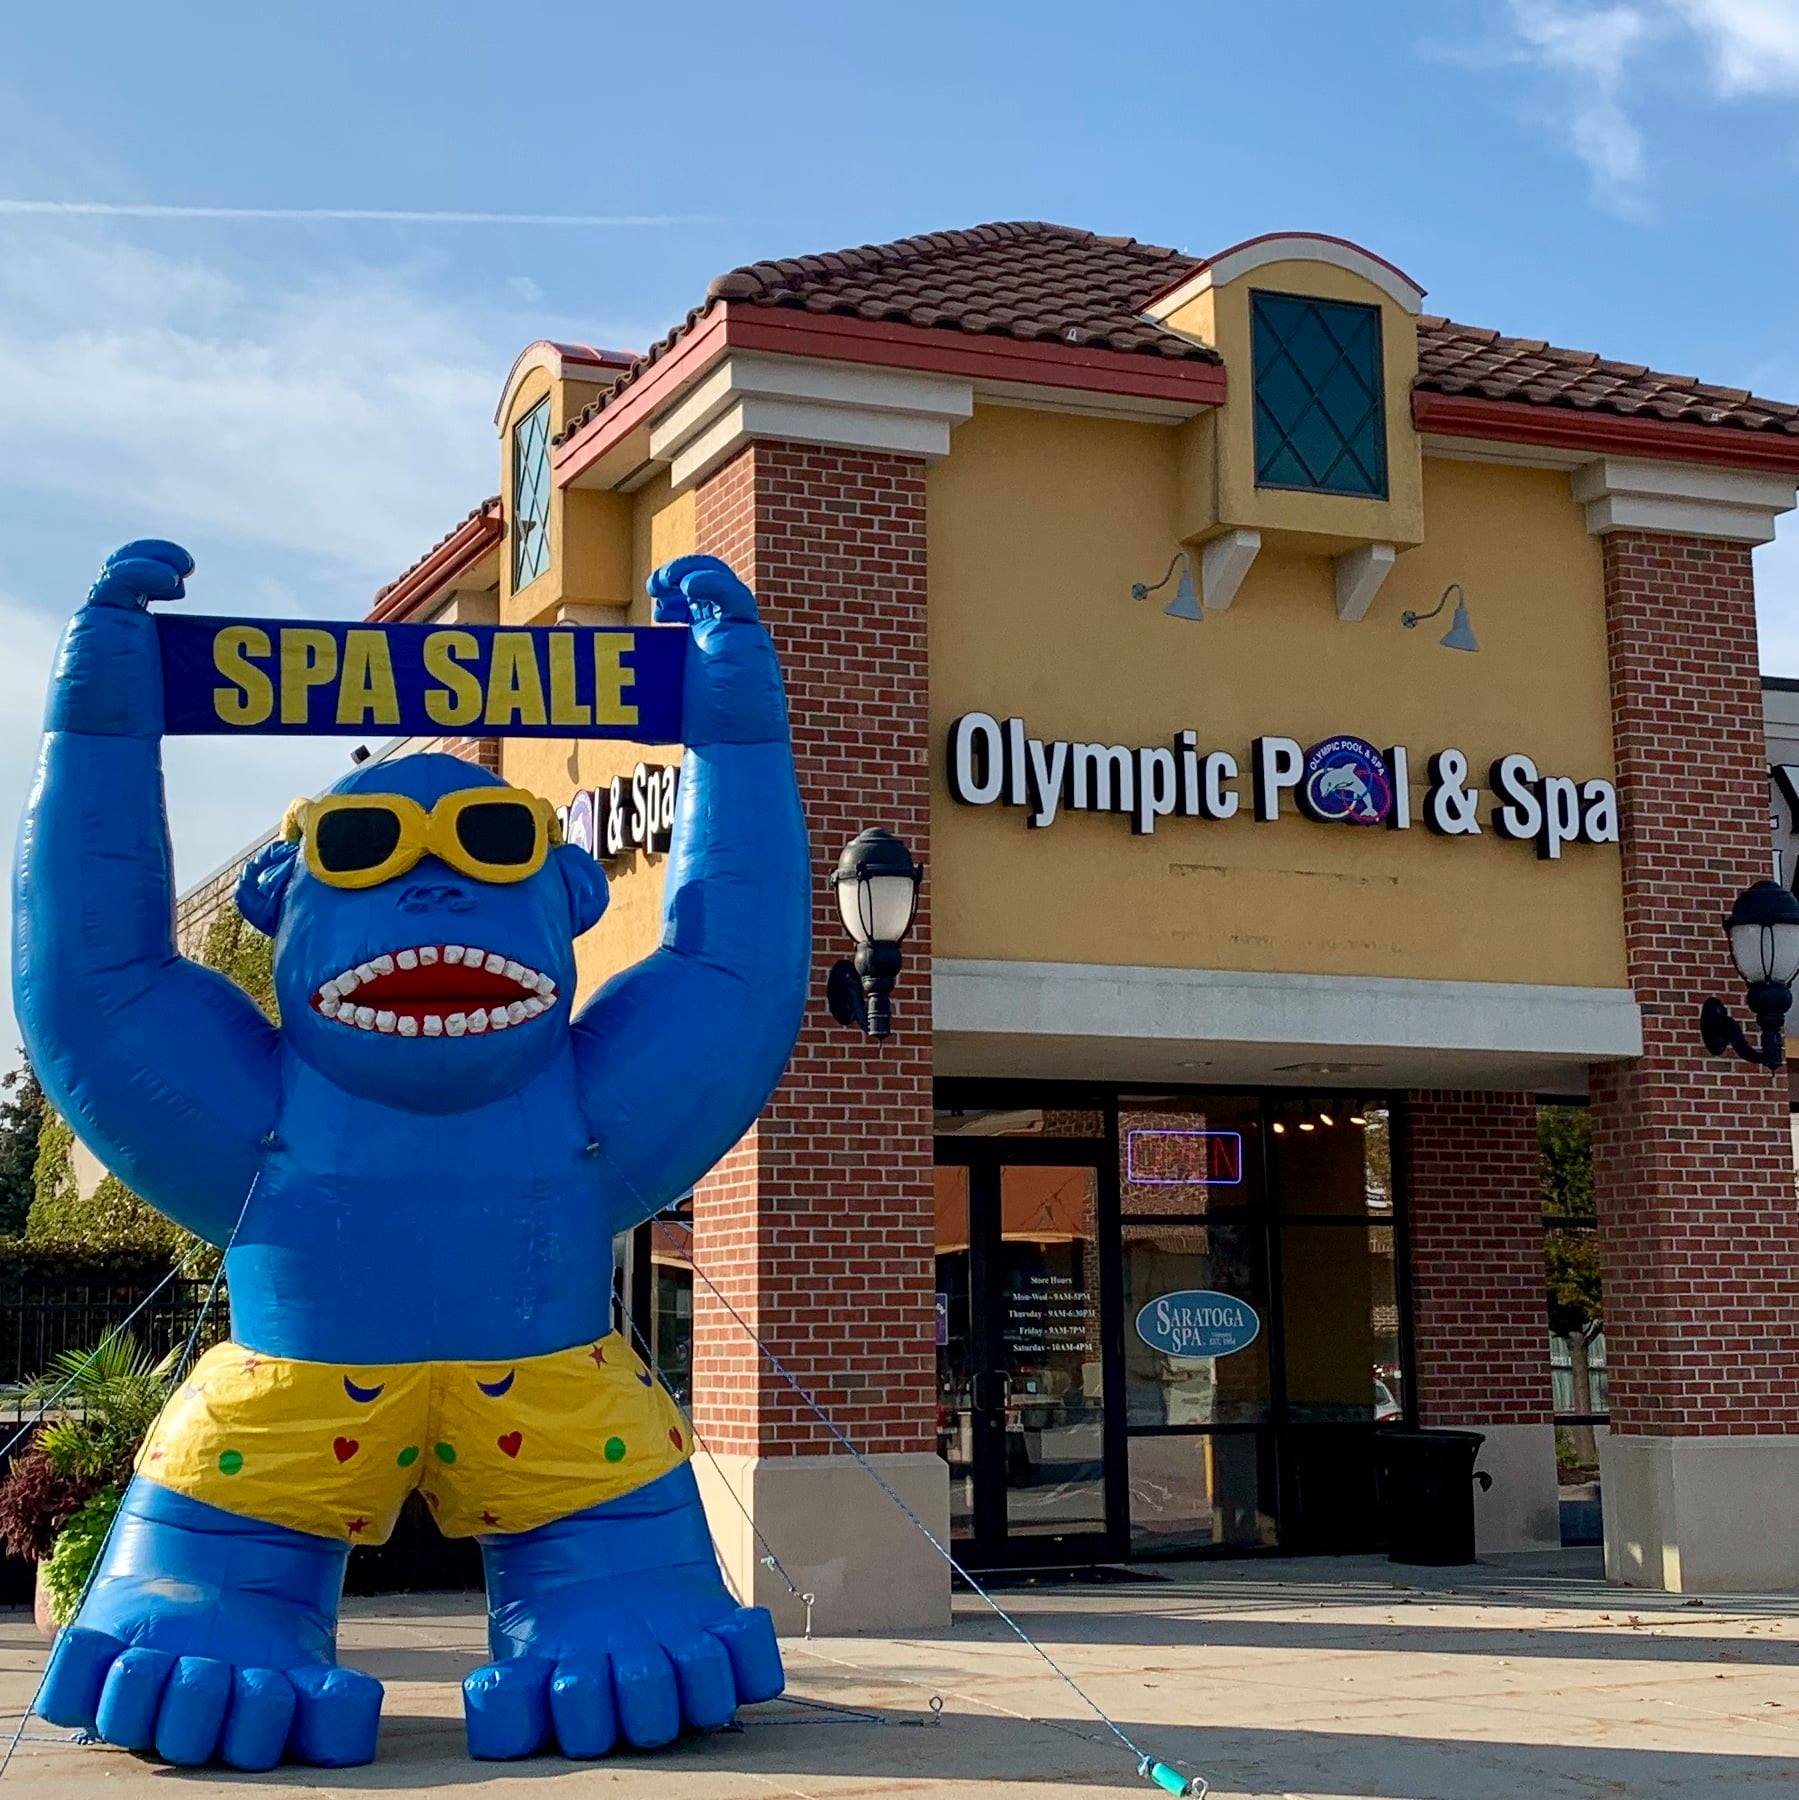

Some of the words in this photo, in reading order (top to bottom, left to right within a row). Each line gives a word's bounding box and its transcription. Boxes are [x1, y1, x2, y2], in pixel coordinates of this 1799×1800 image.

[213, 625, 400, 726] SPA
[424, 631, 639, 726] SALE
[1309, 741, 1340, 770] OLYMPIC
[1341, 741, 1363, 755] POOL
[1371, 756, 1384, 776] SPA
[954, 711, 1239, 834] Olympic
[1433, 748, 1482, 834] &
[1500, 753, 1620, 859] Spa
[607, 774, 624, 854] &
[632, 761, 676, 854] Spa
[1030, 1276, 1049, 1284] Store
[1050, 1276, 1072, 1284] Hours
[1008, 1309, 1042, 1320] Thursday
[1019, 1326, 1043, 1337] Friday
[1157, 1300, 1245, 1335] SARATOGA
[1012, 1343, 1046, 1352] Saturday
